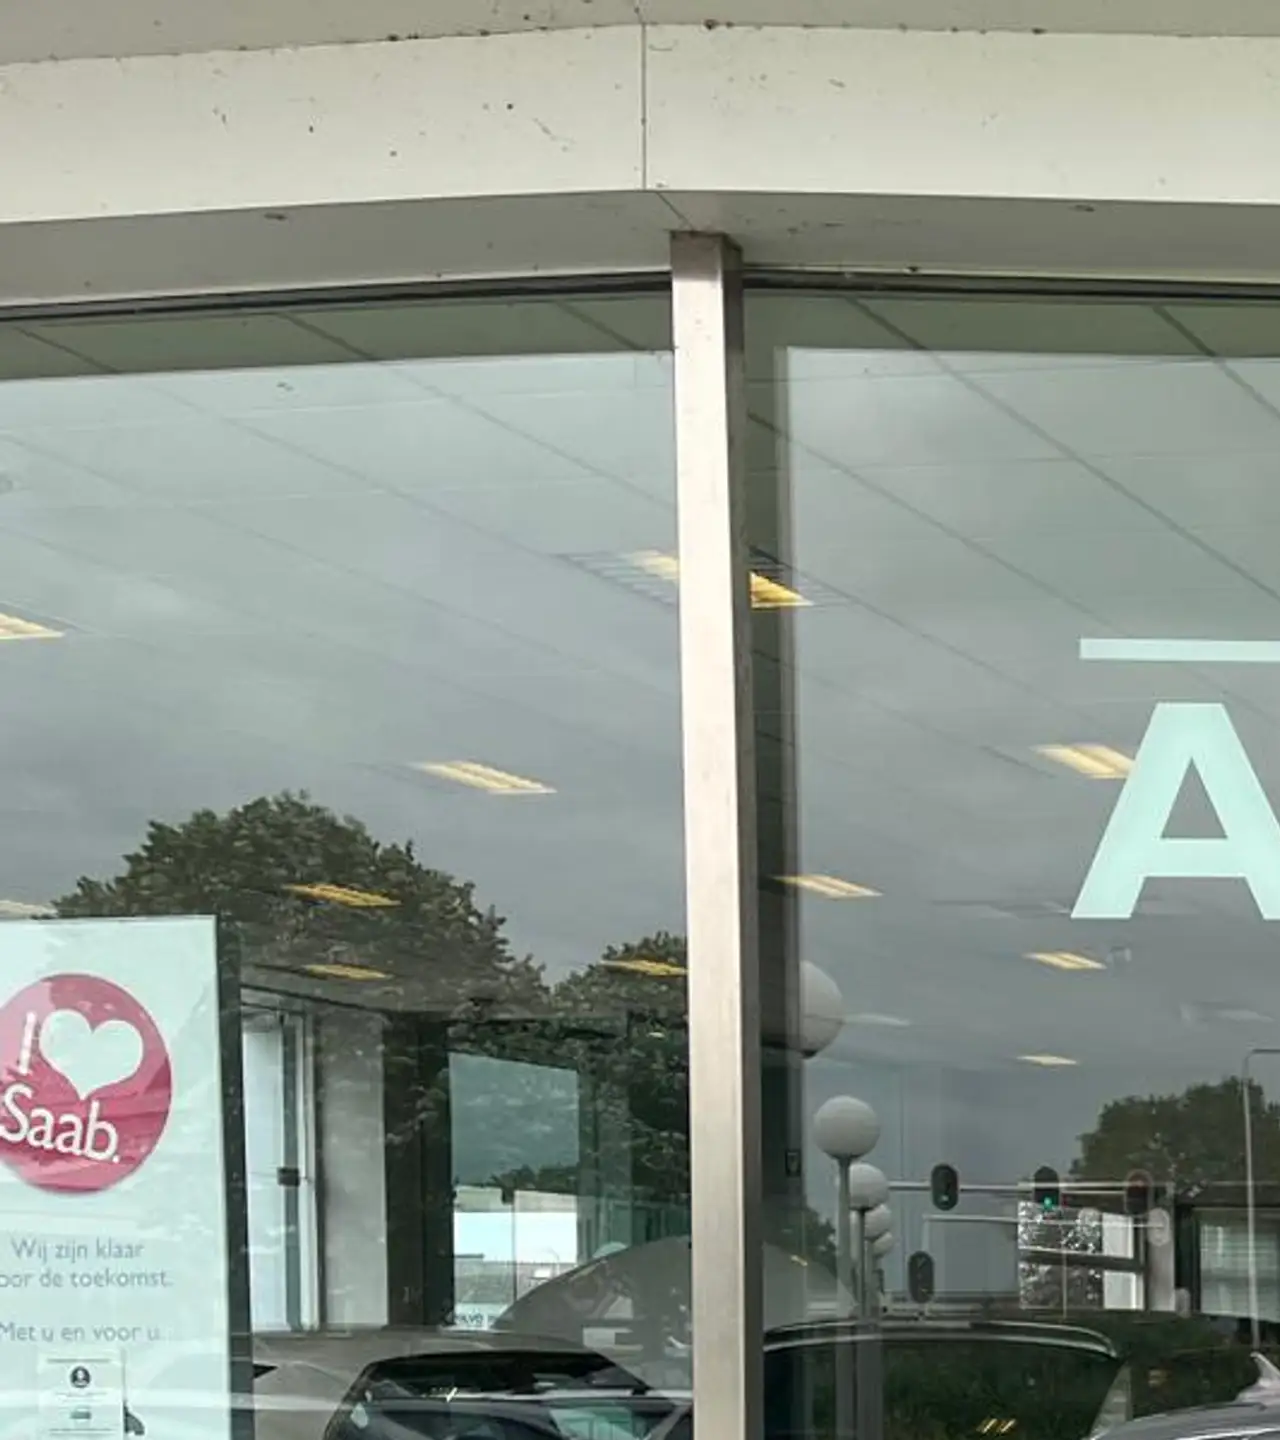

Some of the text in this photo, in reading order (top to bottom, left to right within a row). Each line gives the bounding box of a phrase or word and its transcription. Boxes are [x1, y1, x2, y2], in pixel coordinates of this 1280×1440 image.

[0, 1083, 119, 1163] Saab.
[11, 1235, 144, 1265] Wij zijn klaar
[39, 1268, 63, 1288] de
[70, 1267, 173, 1288] toekomst.
[0, 1322, 36, 1342] Met
[41, 1327, 54, 1343] u
[61, 1326, 85, 1342] en
[93, 1325, 142, 1342] voor
